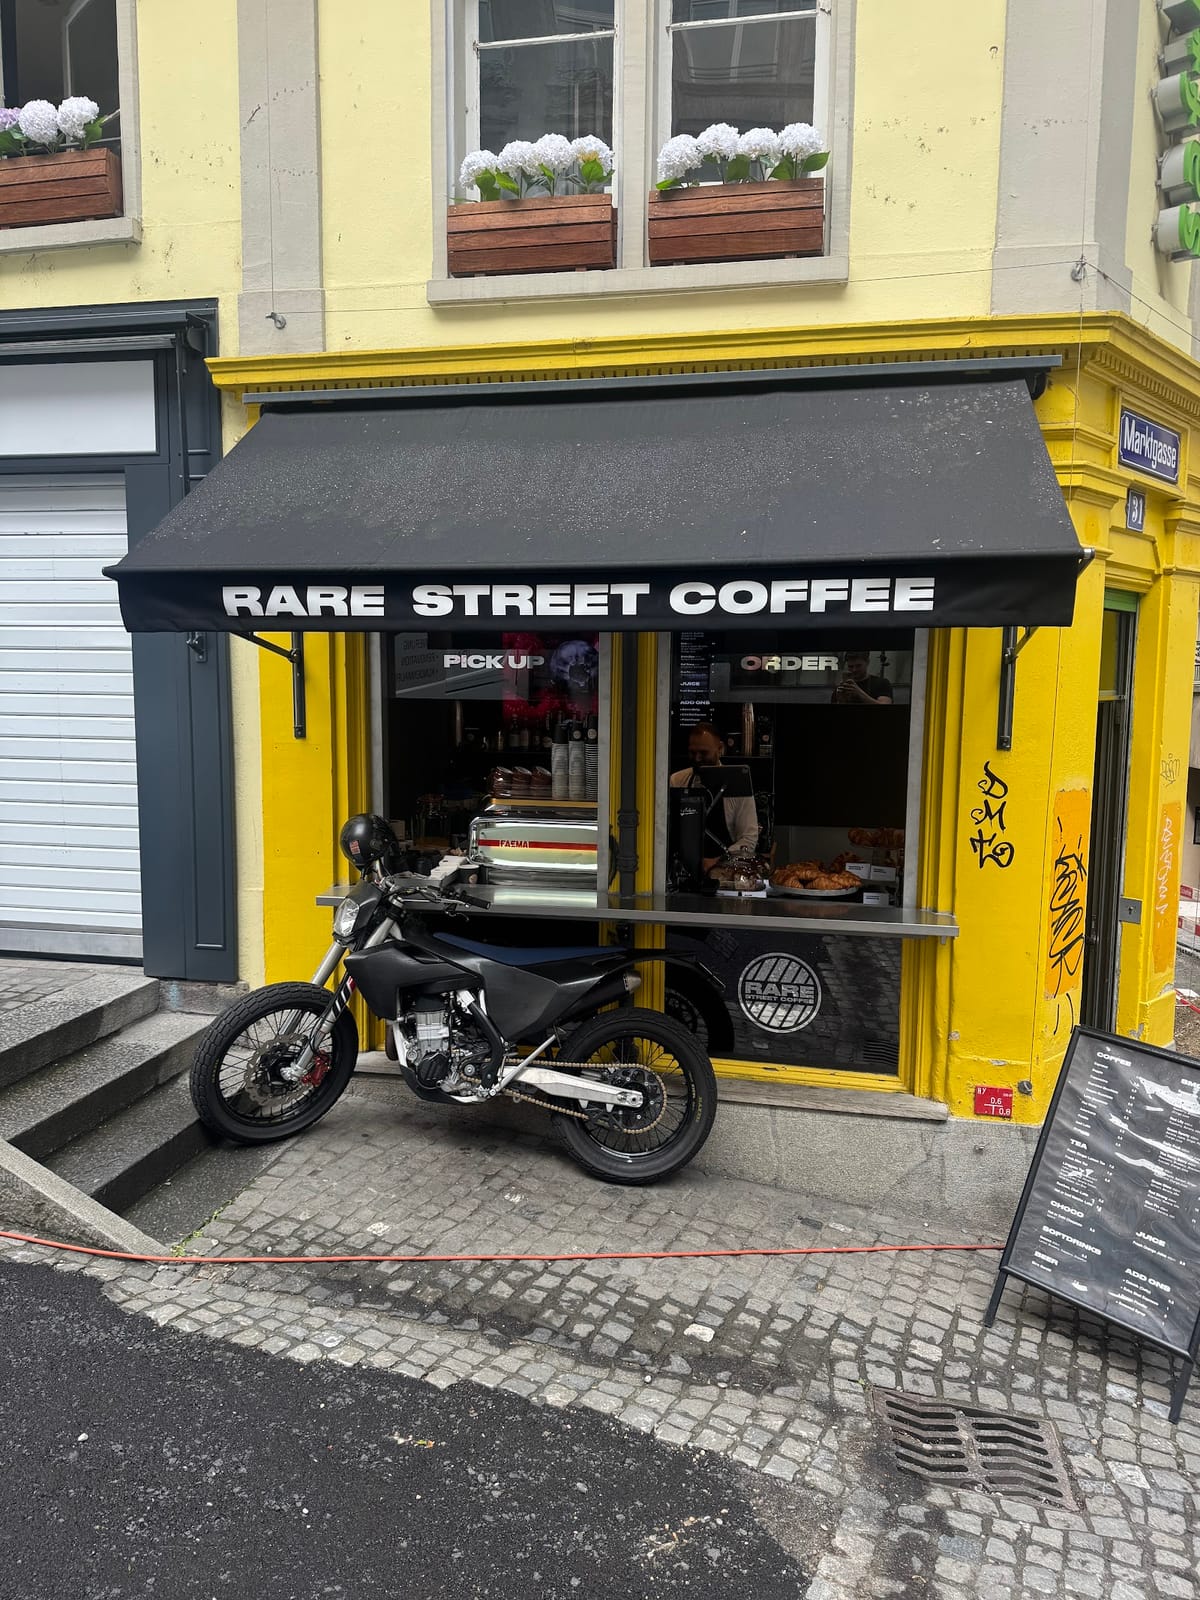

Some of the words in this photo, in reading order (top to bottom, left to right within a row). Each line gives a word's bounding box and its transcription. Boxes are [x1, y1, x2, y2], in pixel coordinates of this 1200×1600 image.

[1123, 416, 1178, 469] Marktgasse
[1132, 496, 1143, 524] 31
[222, 585, 385, 617] RARE
[412, 583, 650, 616] STREET
[669, 577, 936, 615] COFFEE
[443, 655, 504, 669] PICK
[507, 655, 545, 669] UP
[740, 655, 839, 671] ORDER
[500, 840, 528, 848] FAEMA
[744, 981, 815, 999] RARE
[1096, 1051, 1131, 1067] COFFEE
[1070, 1138, 1087, 1149] TEA
[1050, 1200, 1084, 1217] CHOCO
[1042, 1226, 1102, 1255] SOFTDRINKS
[1135, 1231, 1166, 1247] JUICE
[1034, 1250, 1058, 1266] BEER
[1124, 1268, 1147, 1281] ADD
[1147, 1278, 1171, 1293] ONS
